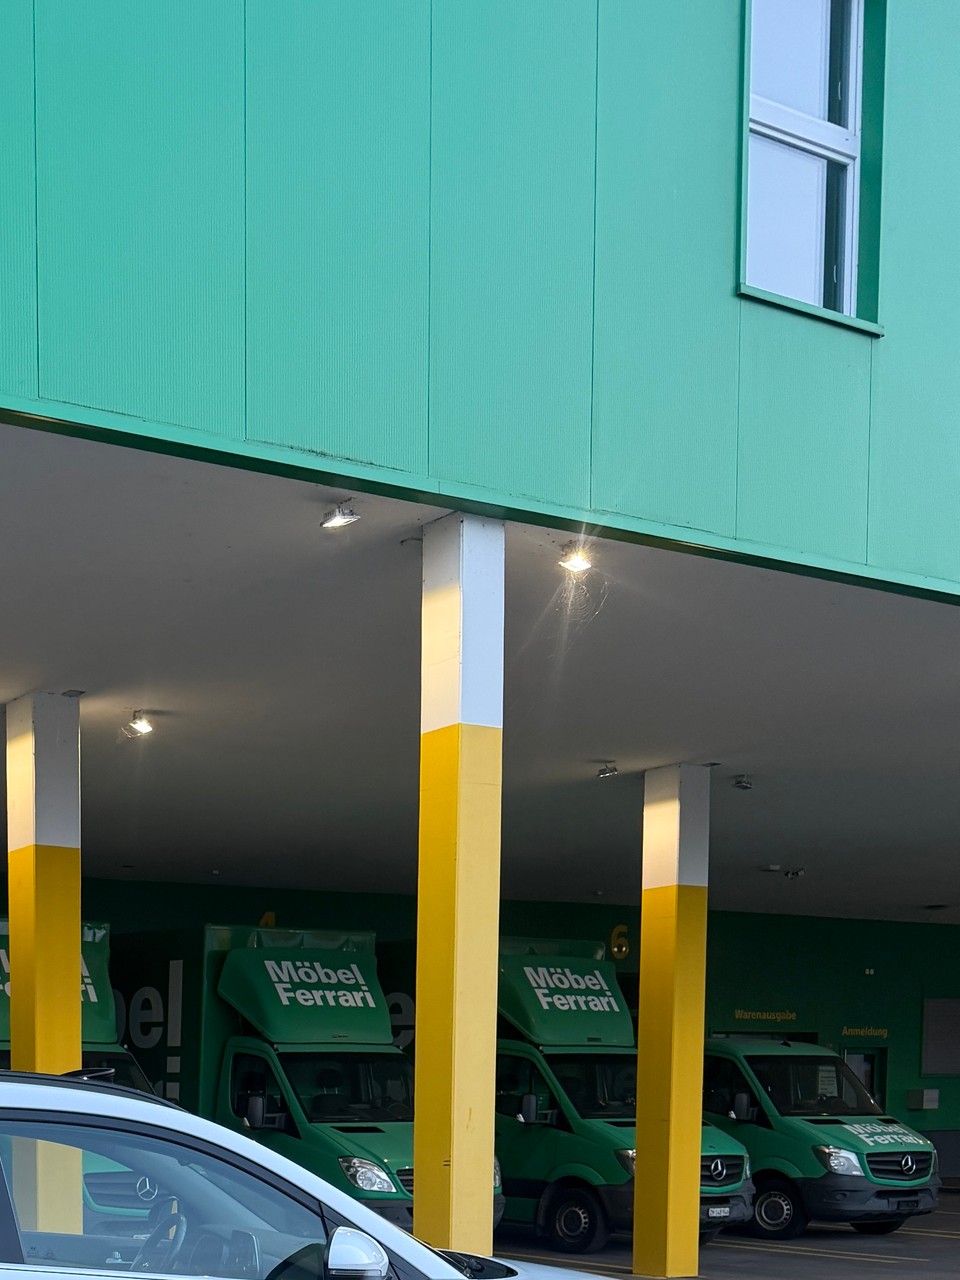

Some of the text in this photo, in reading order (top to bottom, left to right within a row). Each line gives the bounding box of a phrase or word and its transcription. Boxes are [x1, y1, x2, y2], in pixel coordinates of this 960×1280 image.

[610, 924, 630, 960] 6
[264, 960, 366, 985] Möbel
[522, 966, 608, 990] Möbel
[274, 983, 376, 1008] Ferrari
[534, 988, 620, 1012] Ferrari
[734, 1009, 797, 1022] Warenausgabe
[842, 1026, 888, 1038] Anmeldung
[843, 1123, 911, 1136] Möbel
[858, 1133, 924, 1146] Ferrari
